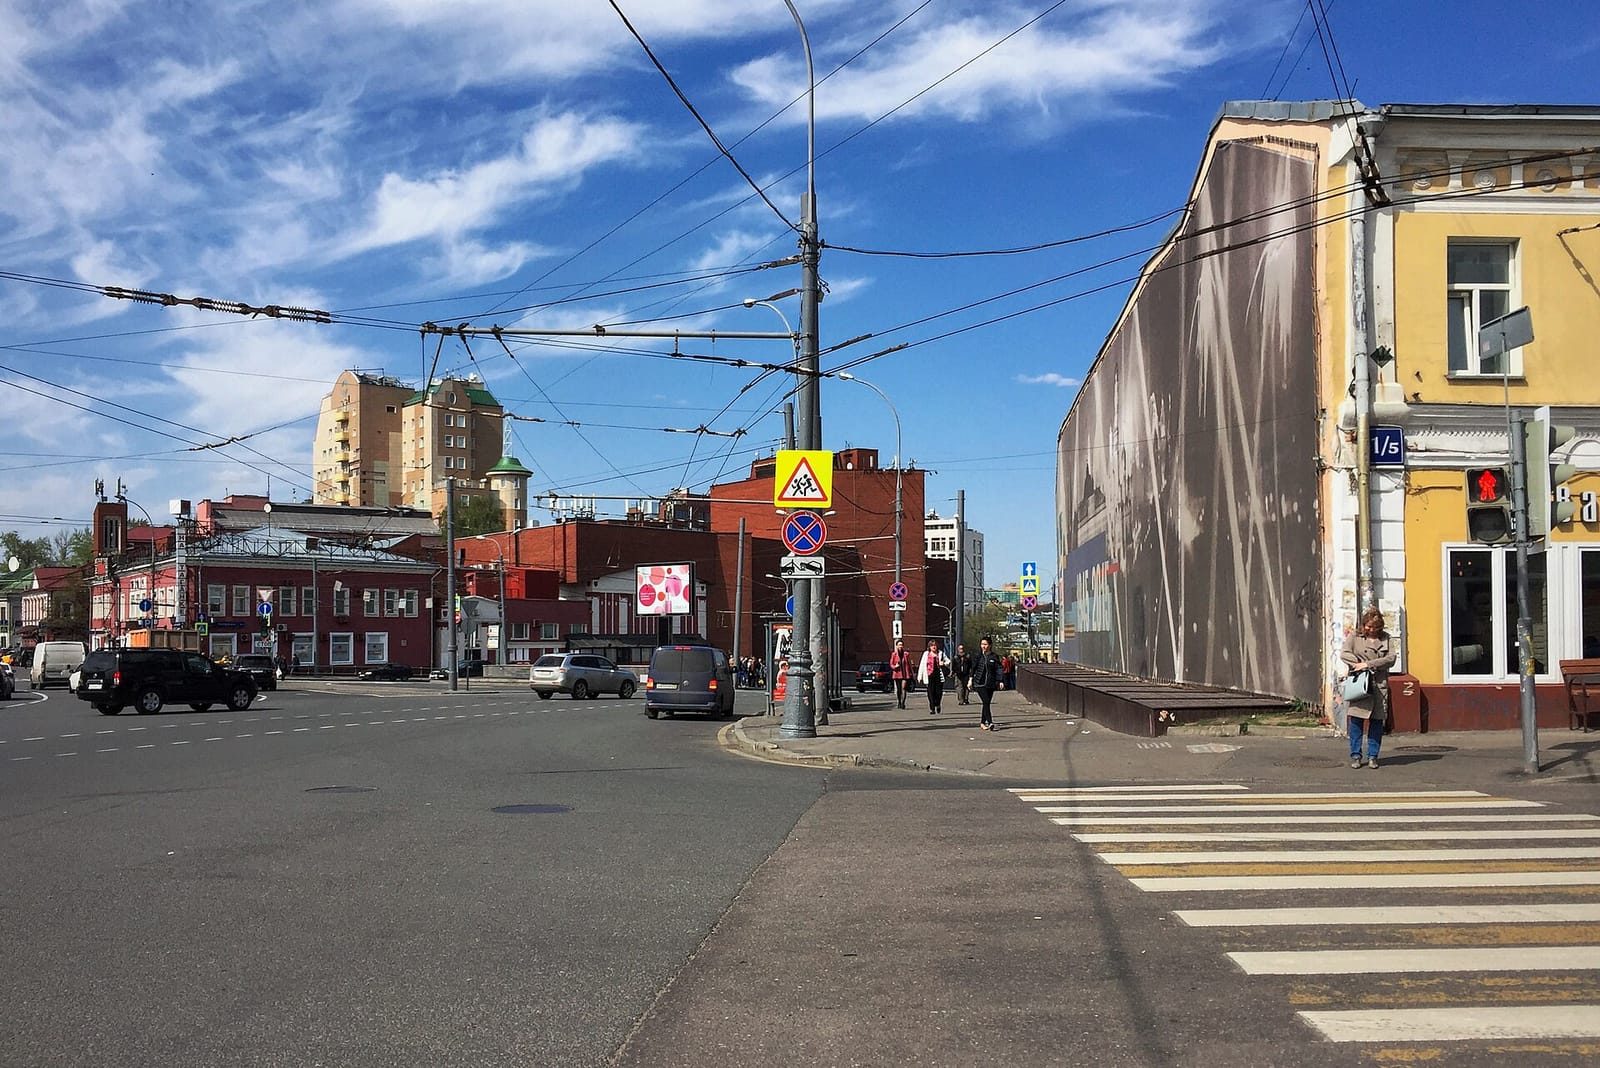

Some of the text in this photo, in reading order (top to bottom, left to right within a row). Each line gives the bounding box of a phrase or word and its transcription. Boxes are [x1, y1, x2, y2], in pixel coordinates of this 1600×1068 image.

[1371, 435, 1399, 456] 1/5
[178, 535, 187, 615] НА ТАГАНКЕ
